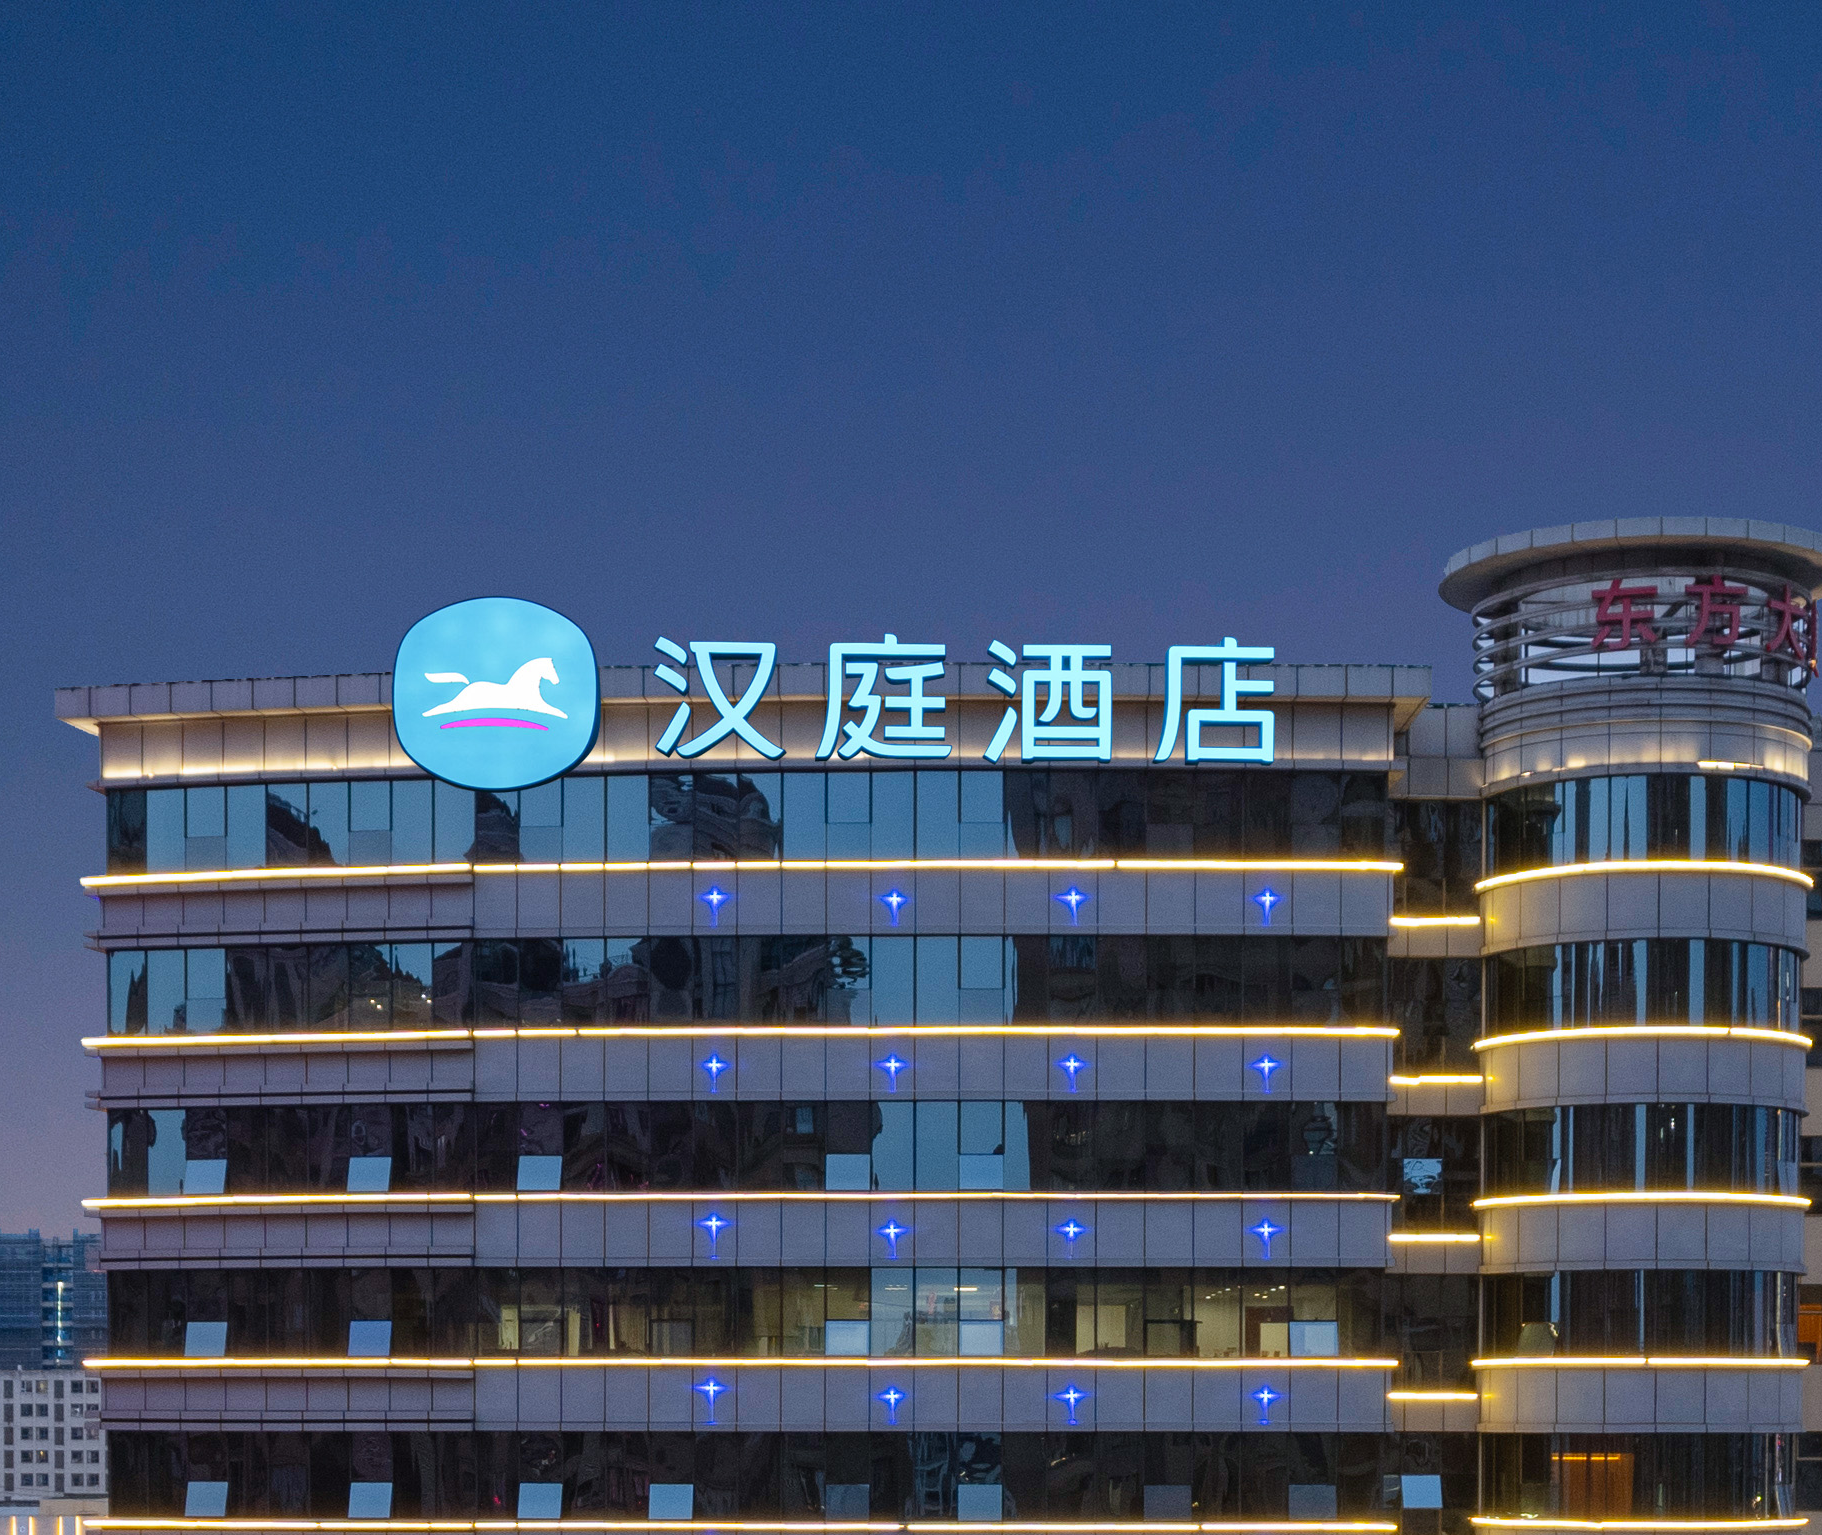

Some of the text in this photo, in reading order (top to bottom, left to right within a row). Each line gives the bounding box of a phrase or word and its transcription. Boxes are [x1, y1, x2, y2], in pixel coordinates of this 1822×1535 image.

[1591, 574, 1819, 678] 东方大
[653, 632, 1276, 765] 汉庭酒店
